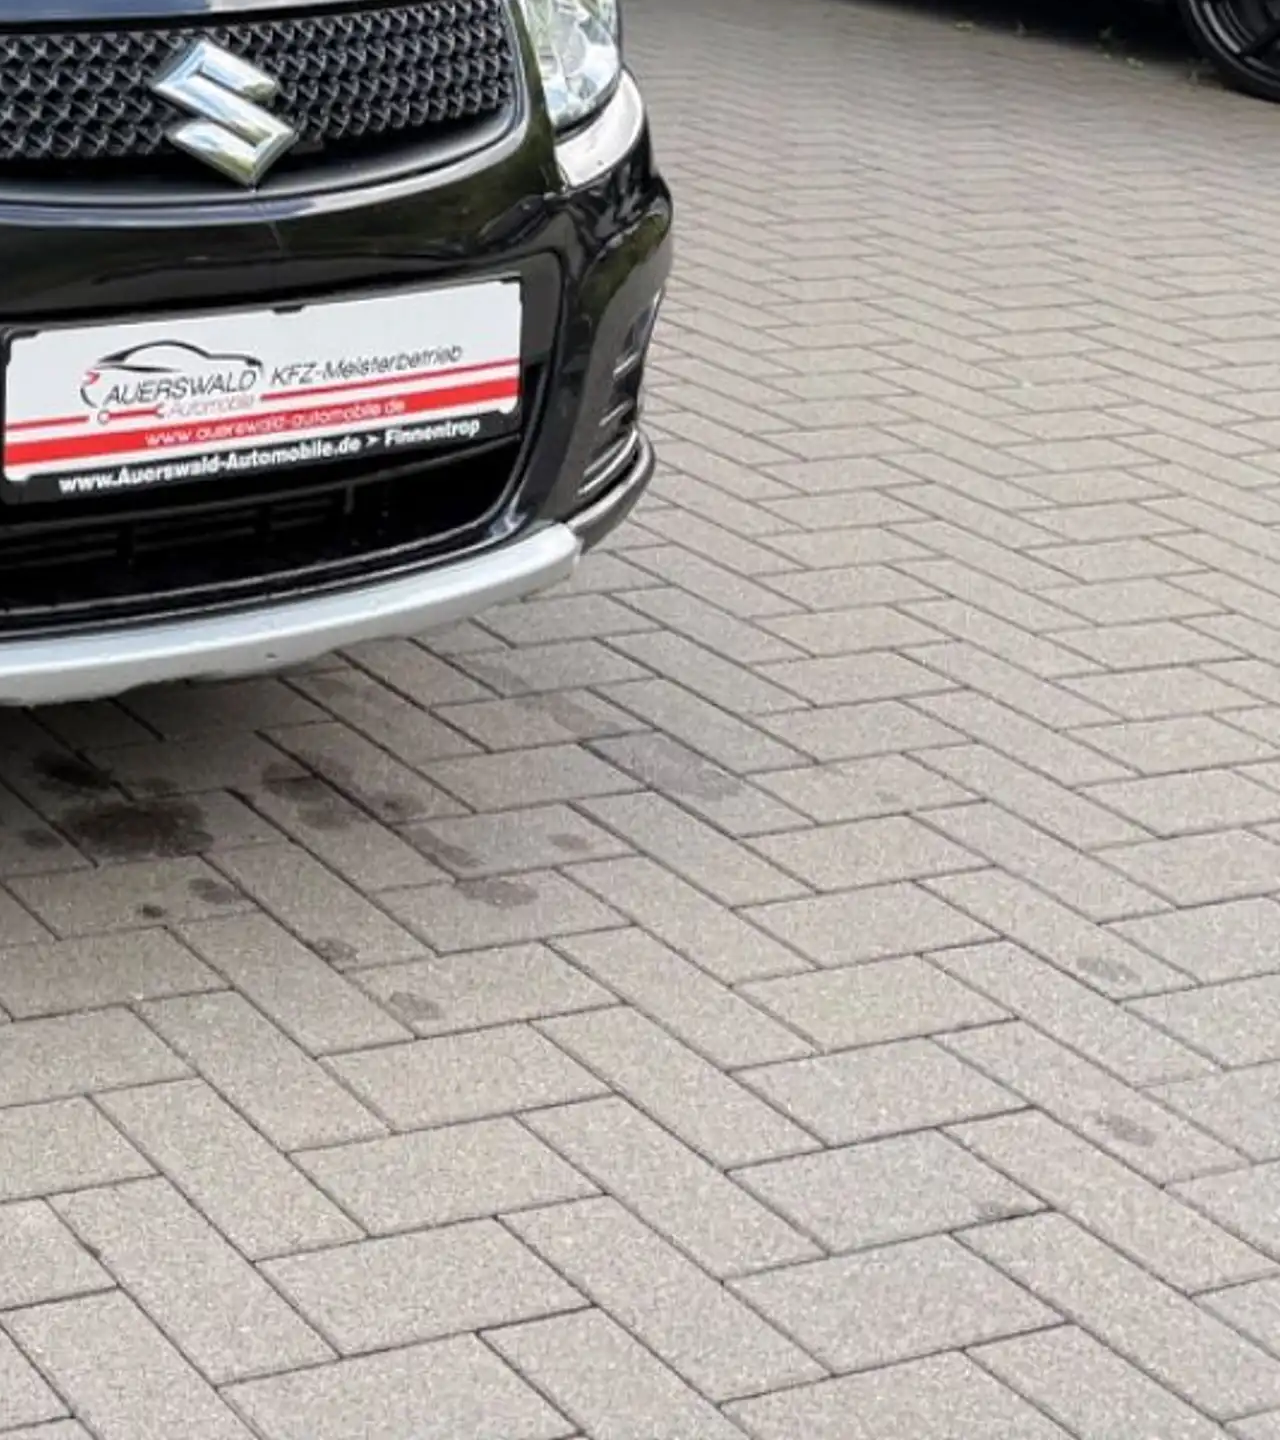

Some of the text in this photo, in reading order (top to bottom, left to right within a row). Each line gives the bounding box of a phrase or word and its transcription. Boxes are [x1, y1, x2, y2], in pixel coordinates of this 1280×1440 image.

[102, 369, 258, 407] AUERSWALD
[269, 345, 463, 388] KFZ-Meisterbetrieb
[57, 417, 481, 494] www.Auerswald-Automobile.de Finnentrop
